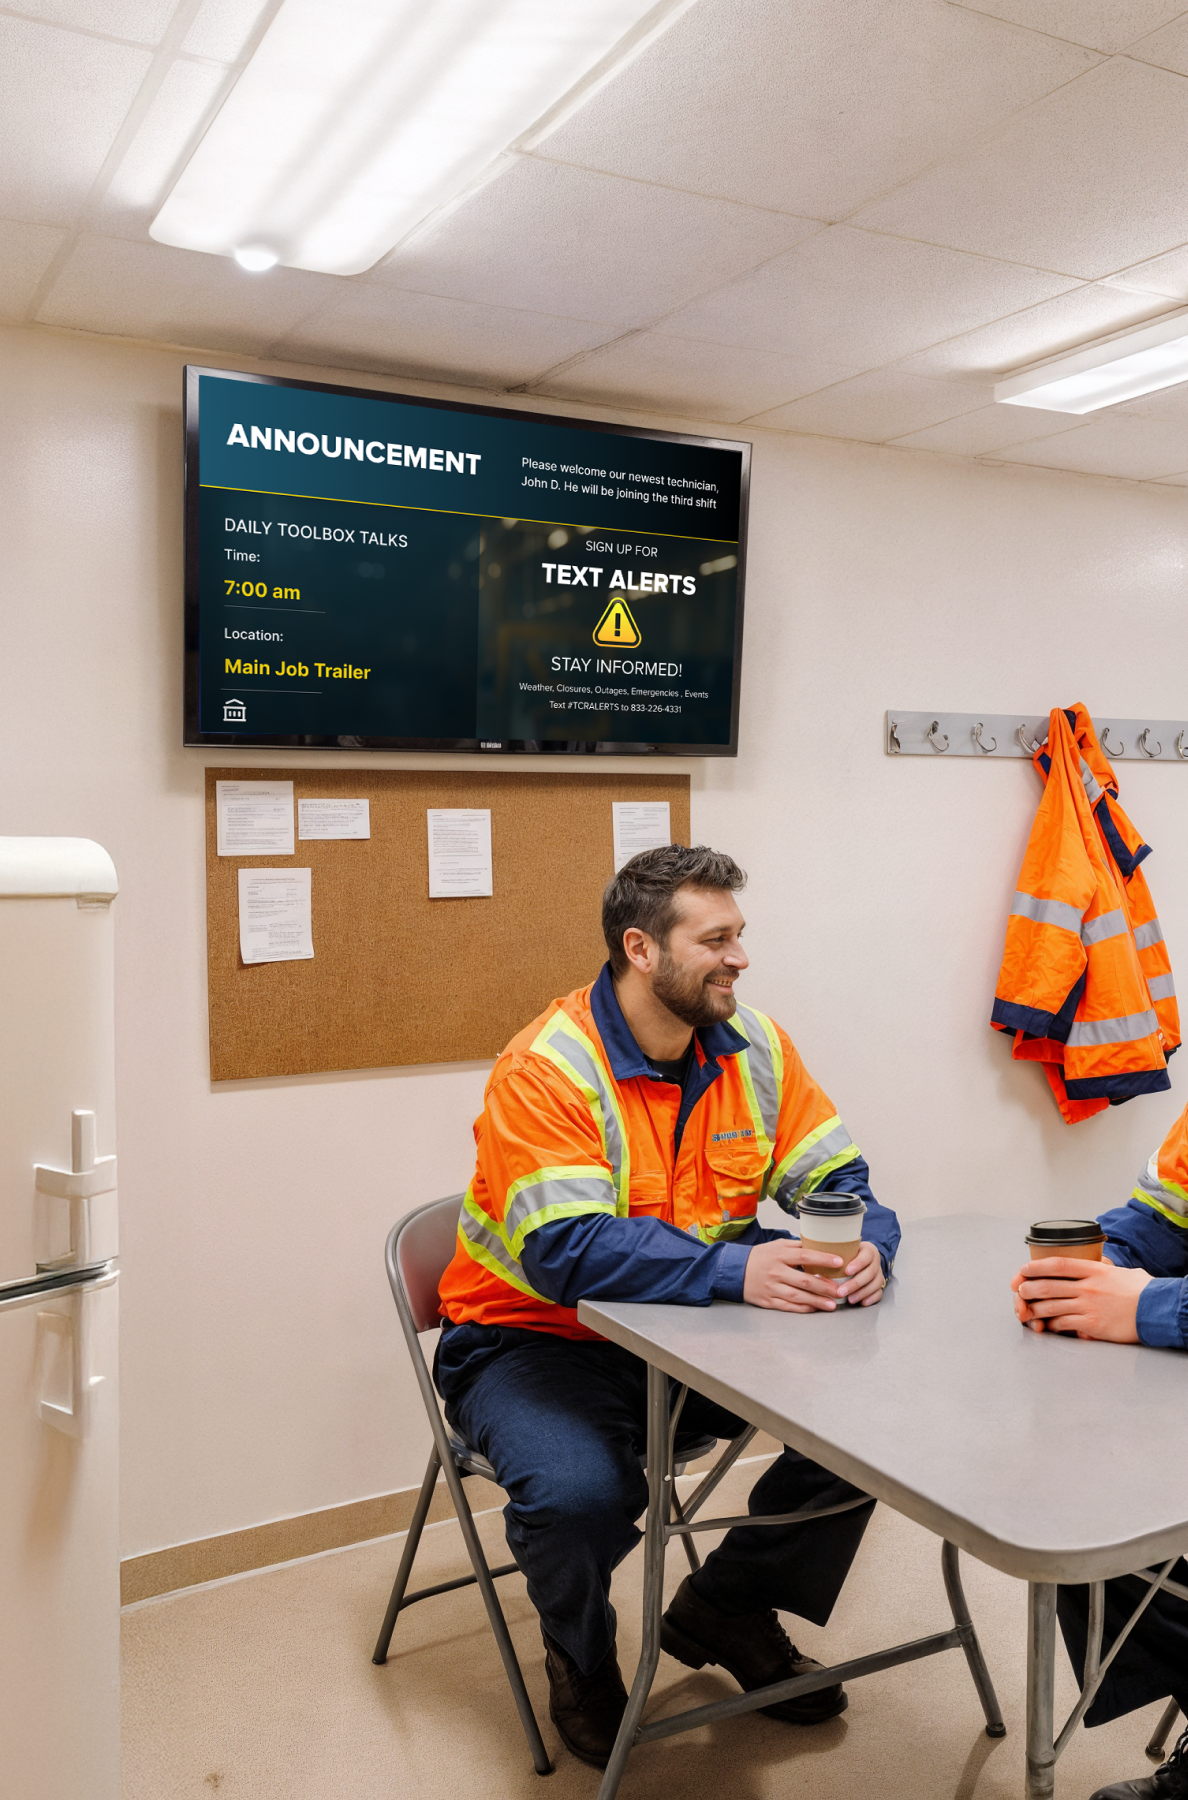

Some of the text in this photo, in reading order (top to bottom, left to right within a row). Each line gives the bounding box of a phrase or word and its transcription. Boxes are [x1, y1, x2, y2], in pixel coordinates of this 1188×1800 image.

[226, 424, 481, 475] ANNOUNCEMENT
[522, 457, 719, 494] Please welcome our newest technician,
[521, 476, 716, 509] John D. He will be joining the third shift
[225, 518, 408, 547] DAILY TOOLBOX TALKS
[224, 549, 260, 562] Time:
[586, 540, 658, 557] SIGN UP FOR
[542, 563, 696, 595] TEXT ALERTS
[224, 580, 300, 600] 7:00 am
[224, 628, 283, 642] Location:
[225, 659, 371, 680] Main Job Trailer
[551, 656, 682, 677] STAY INFORMED!
[519, 682, 554, 692] Weather,
[556, 684, 592, 694] Closures,
[595, 686, 629, 696] Outages,
[684, 690, 708, 698] Events
[549, 701, 681, 713] Text #TCRALERTS to 833-226-4331
